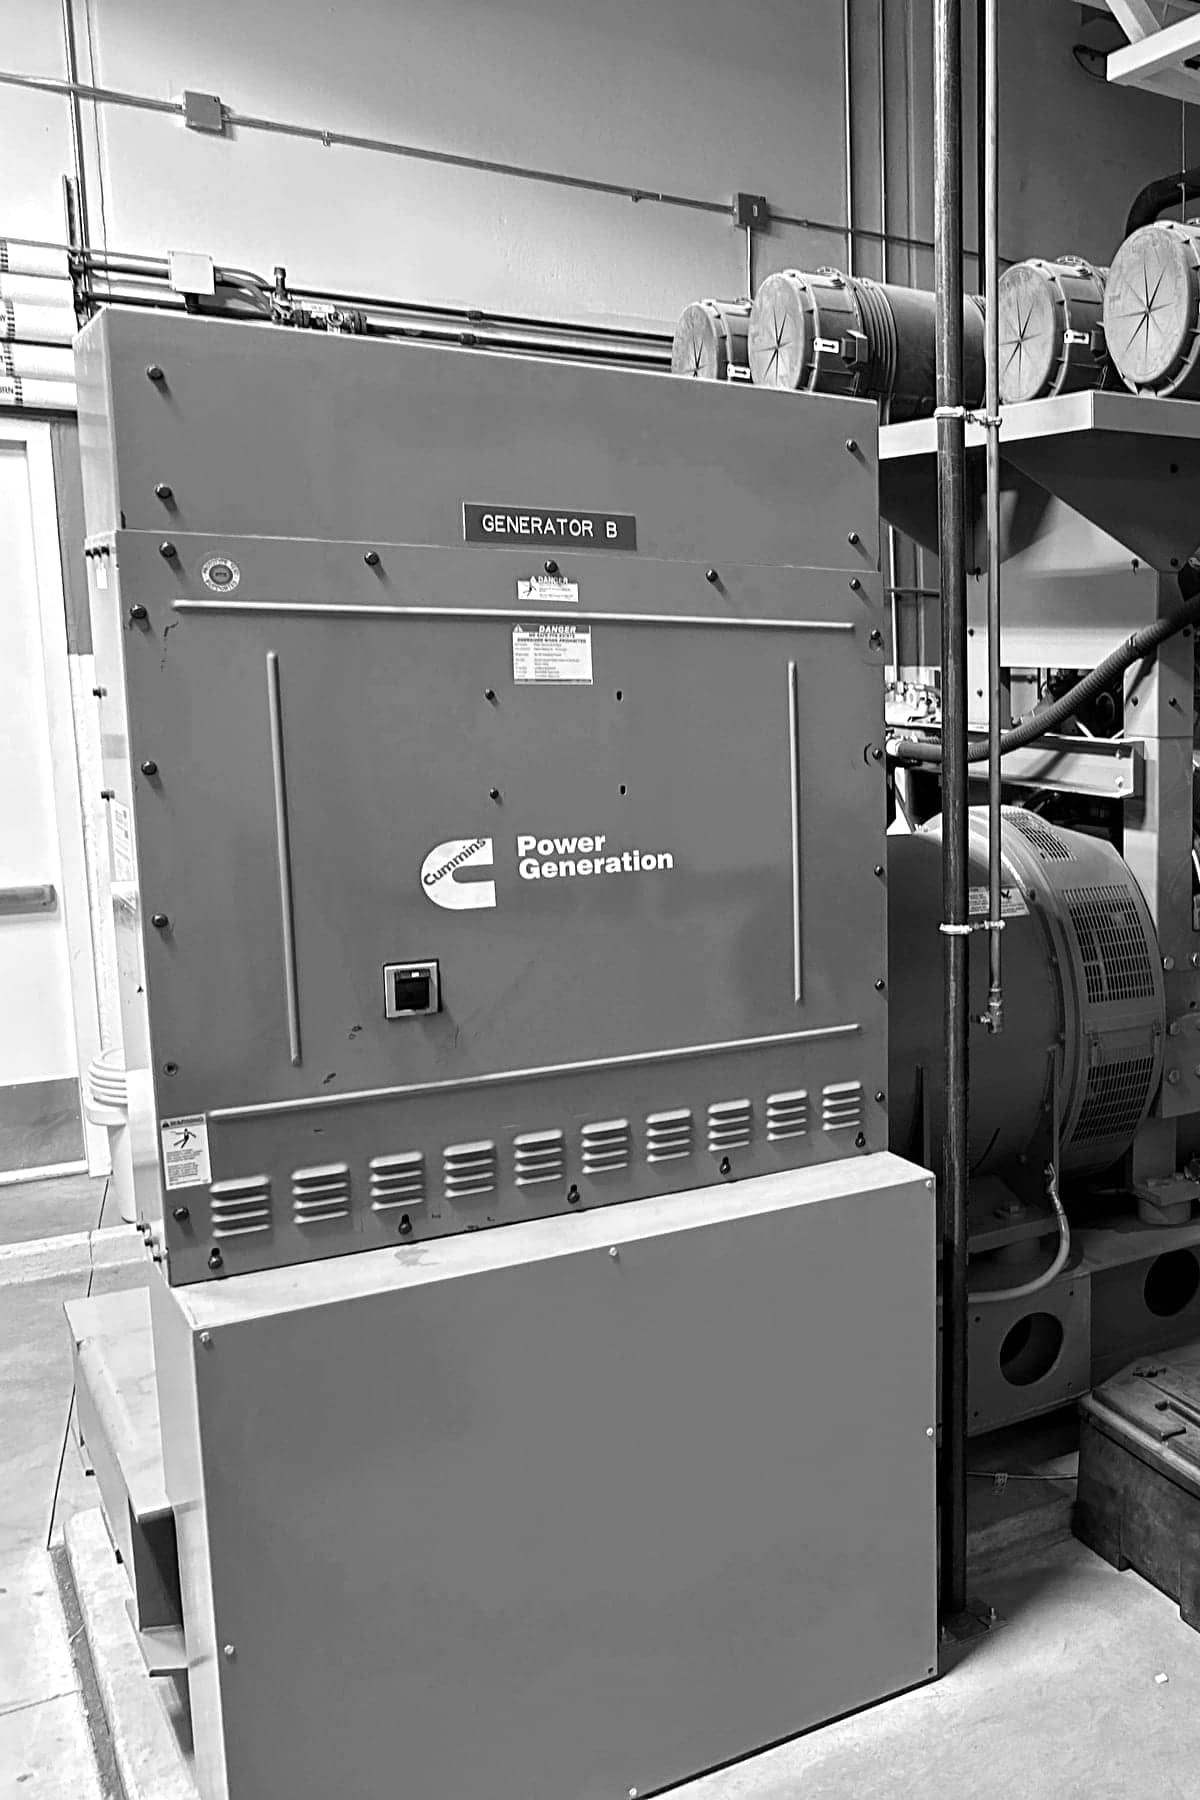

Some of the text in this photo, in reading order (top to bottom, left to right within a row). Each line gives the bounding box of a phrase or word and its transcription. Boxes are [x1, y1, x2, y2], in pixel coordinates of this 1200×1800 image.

[482, 513, 618, 538] GENERATOR B
[538, 624, 577, 633] DANGER
[516, 835, 606, 857] Power
[423, 838, 487, 887] Cummins
[518, 850, 674, 880] Generation
